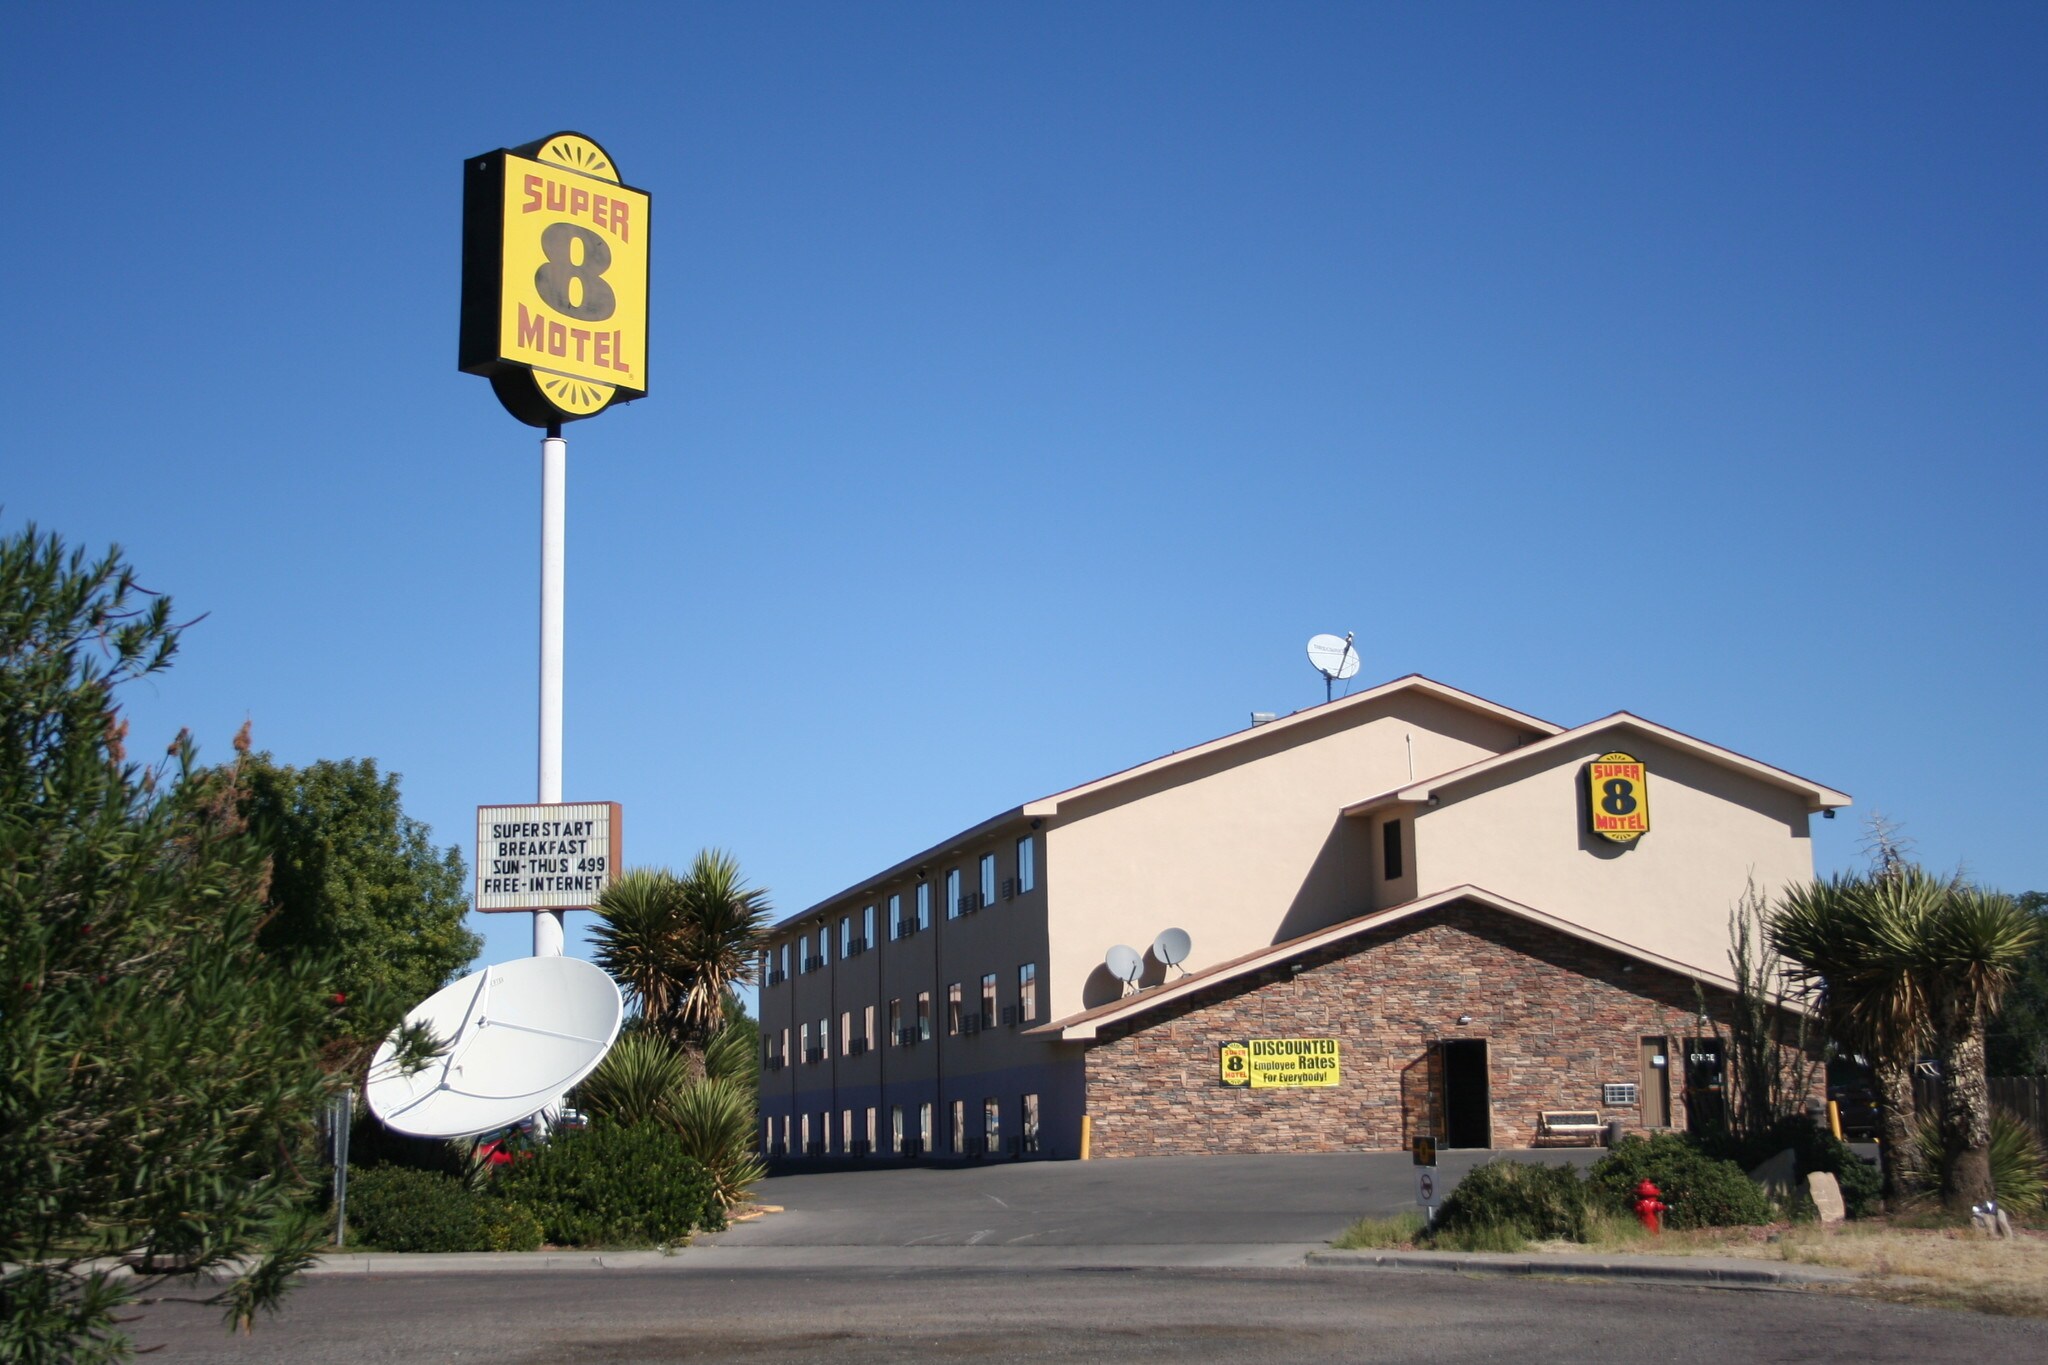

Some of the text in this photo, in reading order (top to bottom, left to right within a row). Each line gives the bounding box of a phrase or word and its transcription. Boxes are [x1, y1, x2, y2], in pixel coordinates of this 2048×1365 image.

[523, 174, 629, 244] SUPER
[534, 222, 616, 322] 8
[518, 302, 629, 373] MOTEL
[1594, 765, 1640, 782] SUPER
[1601, 778, 1637, 815] 8
[1595, 812, 1645, 829] MOTEL
[499, 840, 586, 856] BREAKFAST
[577, 857, 605, 872] 499
[1253, 1040, 1335, 1055] DISCOUNTED
[1227, 1056, 1244, 1071] 8
[1254, 1056, 1335, 1071] Employee Rates
[1690, 1053, 1715, 1061] OFFCE
[1263, 1072, 1327, 1082] For Everybody!
